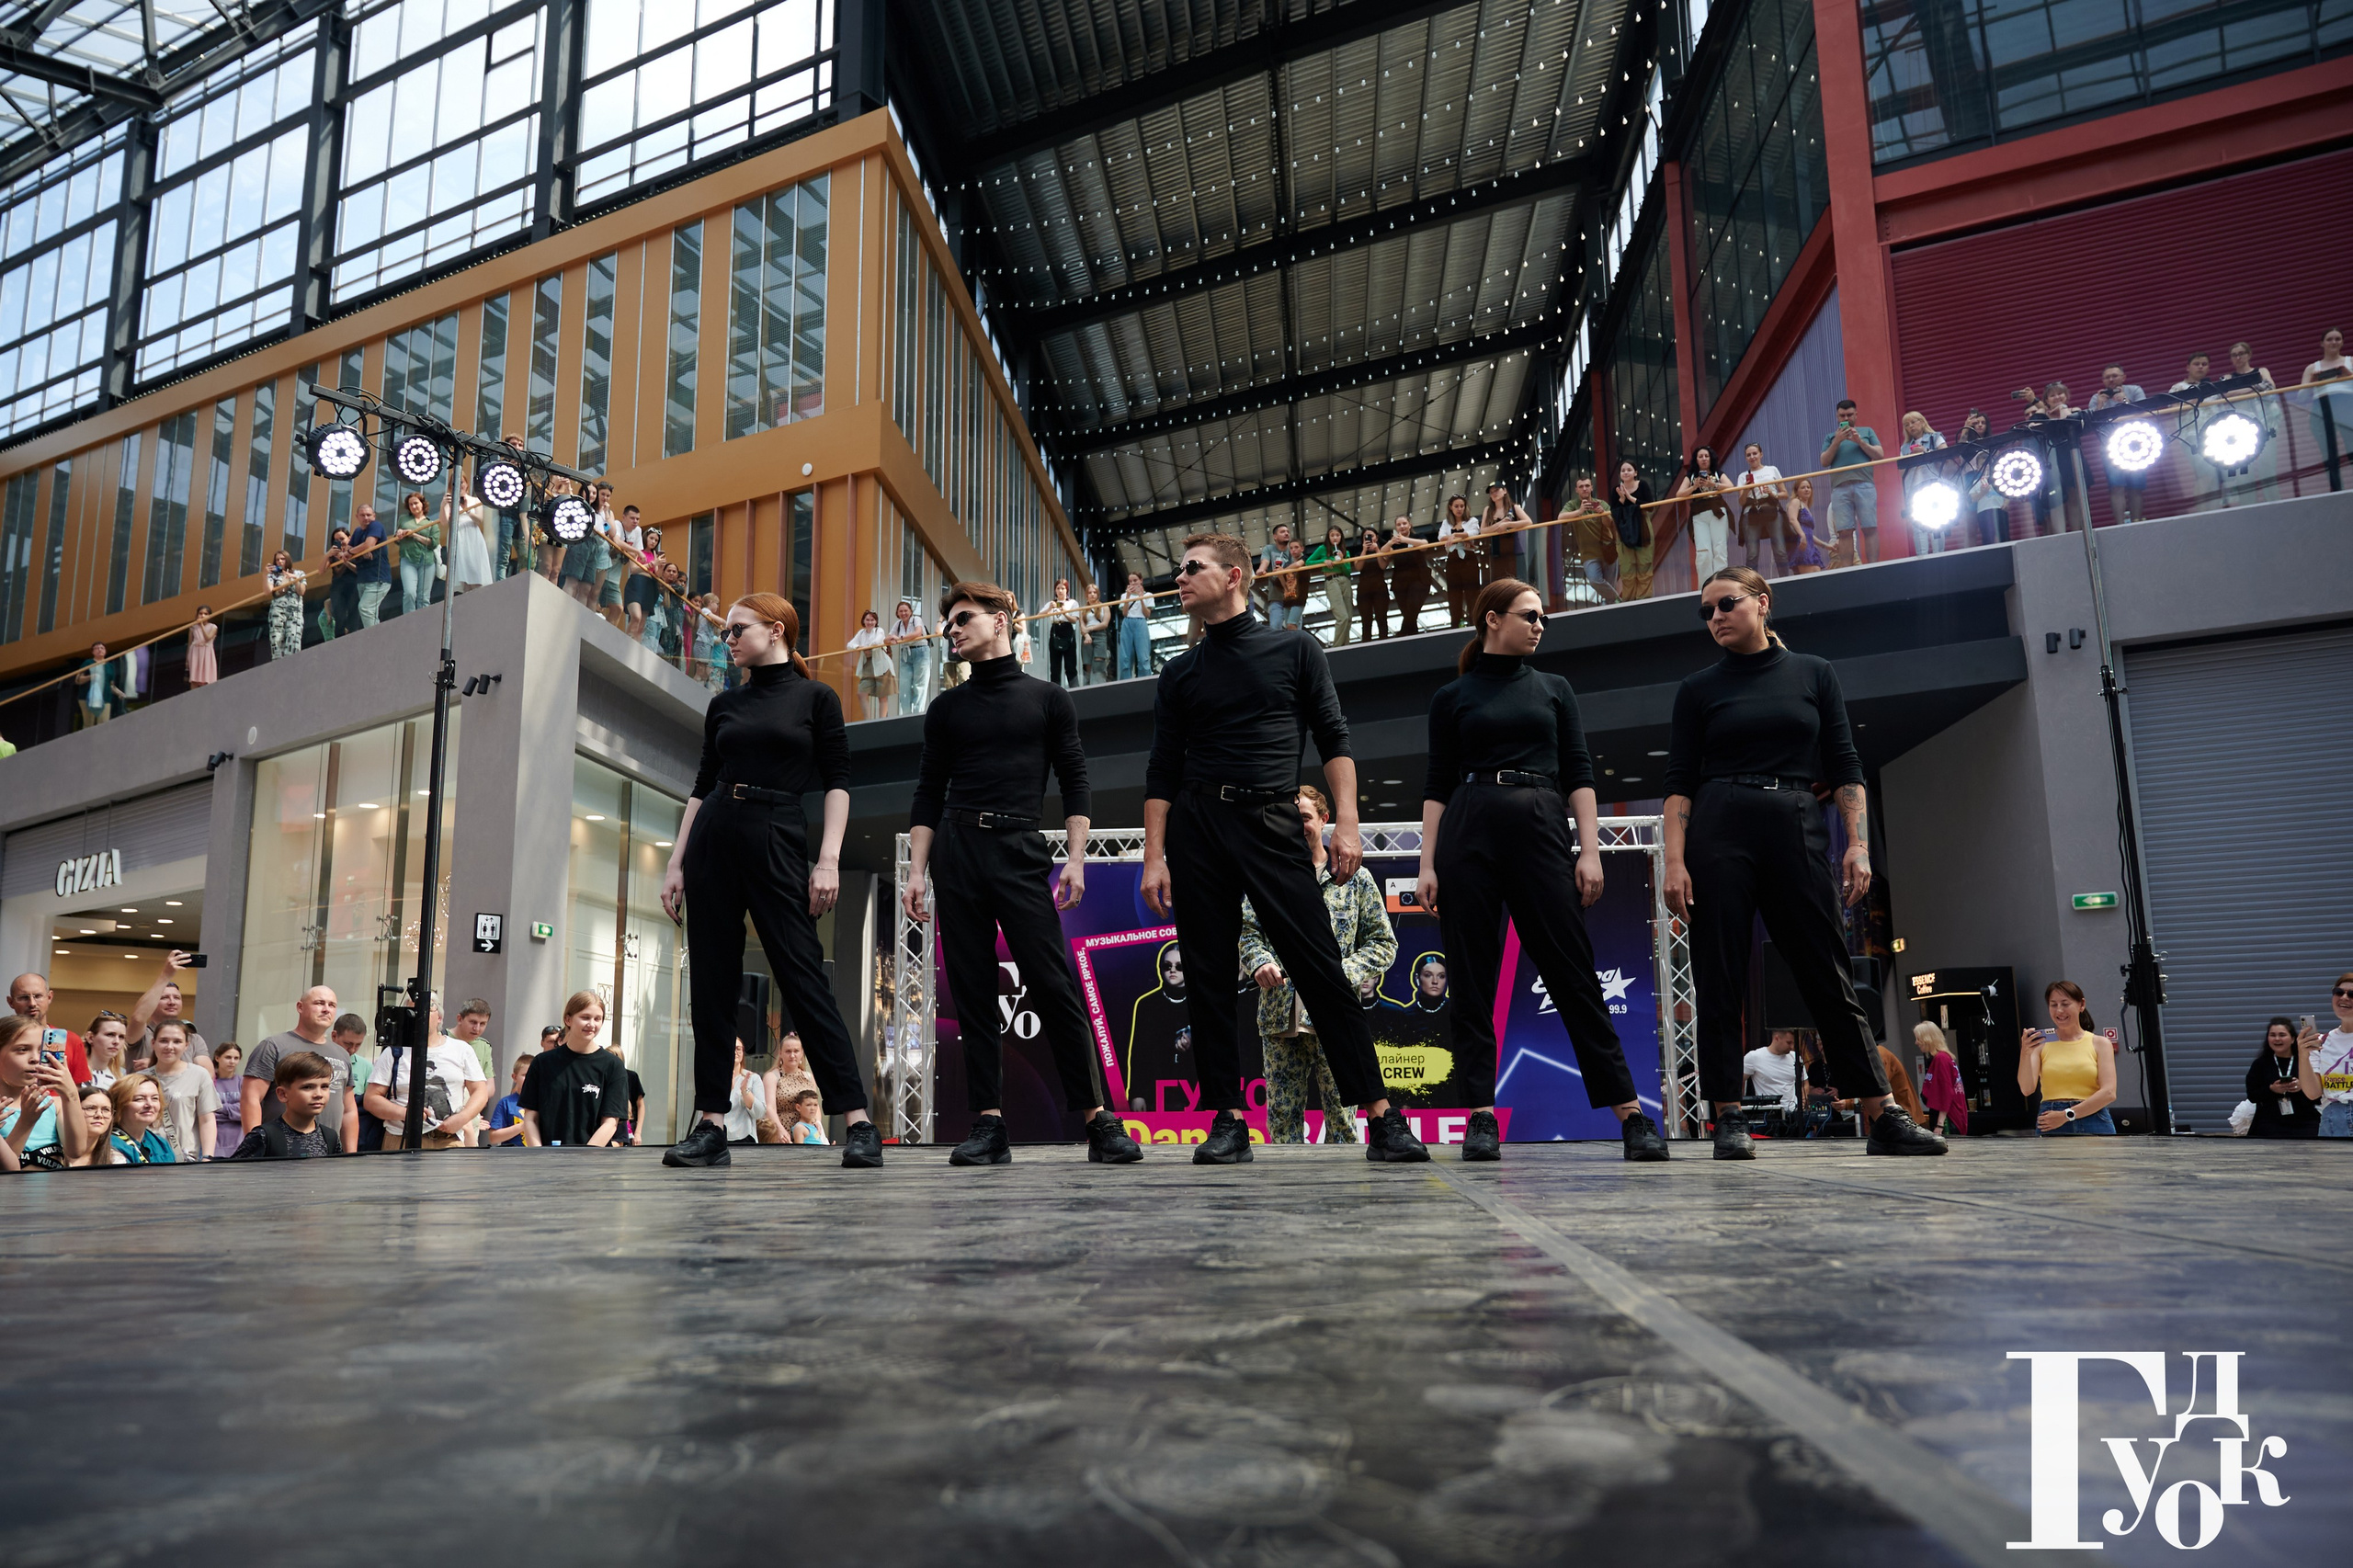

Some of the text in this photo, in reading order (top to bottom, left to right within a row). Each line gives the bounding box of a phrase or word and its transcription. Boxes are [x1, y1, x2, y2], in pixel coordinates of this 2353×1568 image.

[56, 848, 122, 897] GIZIA
[1086, 930, 1158, 948] МУЗЫКАЛЬНОЕ
[1912, 972, 1935, 986] ESSENCE
[1077, 947, 1114, 1067] ПОЖАЛУЙ, САМОЕ ЯРКОЕ,
[1608, 1005, 1628, 1014] 99.9
[1377, 1053, 1425, 1065] лайнер
[1382, 1067, 1425, 1078] CREW
